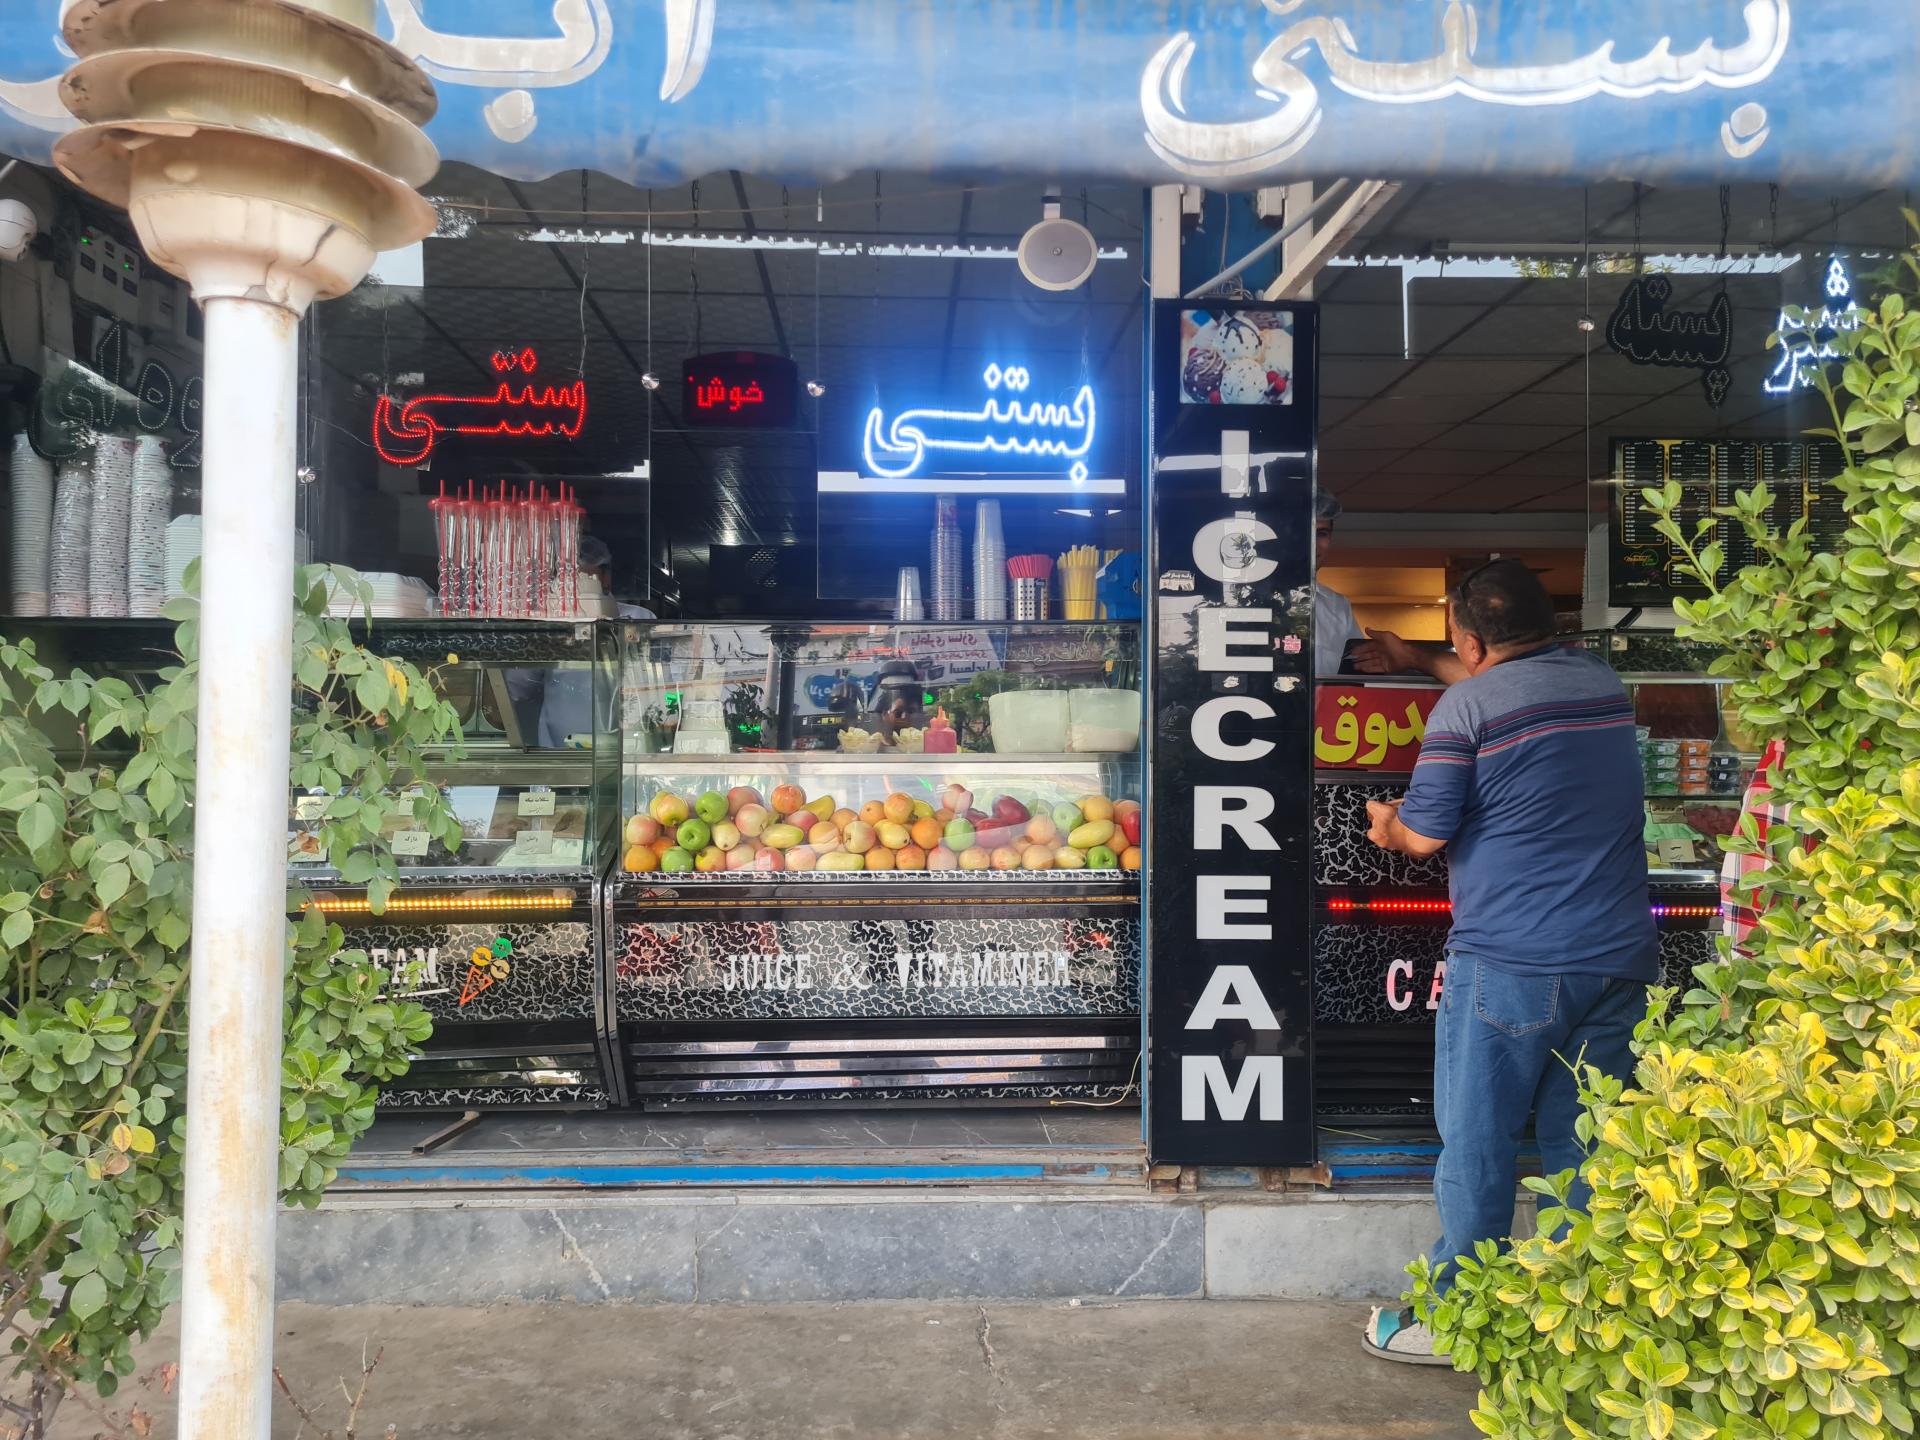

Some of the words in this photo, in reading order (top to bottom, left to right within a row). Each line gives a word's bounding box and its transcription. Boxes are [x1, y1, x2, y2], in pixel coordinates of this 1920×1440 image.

[1611, 277, 1731, 408] پسته
[696, 375, 765, 412] خوش
[863, 361, 1097, 487] بستنی
[1314, 695, 1426, 765] دوق
[723, 953, 812, 991] JUICE
[832, 951, 873, 991] &
